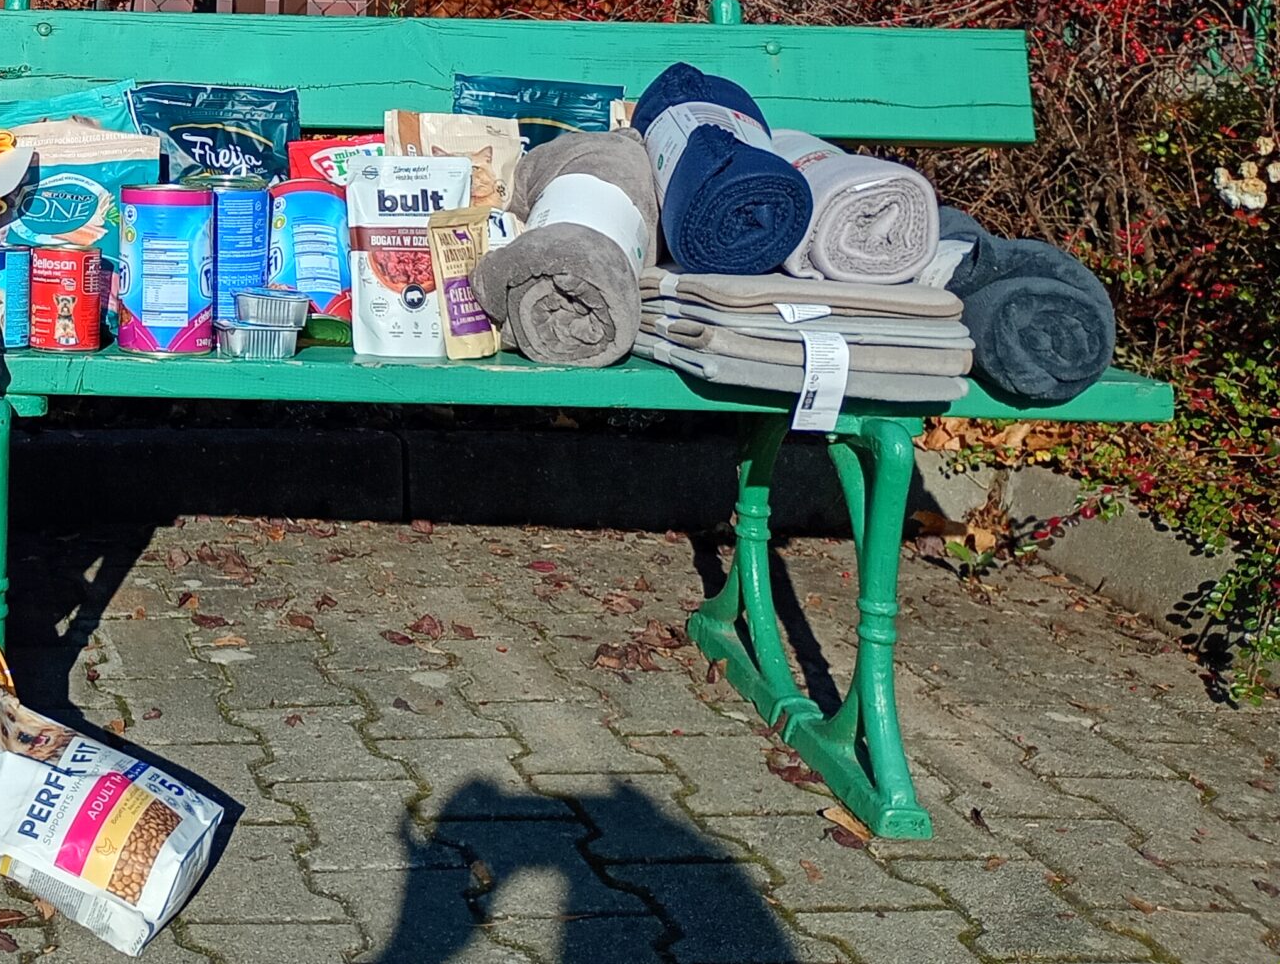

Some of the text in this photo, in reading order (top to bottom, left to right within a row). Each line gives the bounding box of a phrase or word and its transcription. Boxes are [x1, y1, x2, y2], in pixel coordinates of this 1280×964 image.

[182, 133, 263, 178] Freija
[335, 148, 360, 160] mini
[22, 196, 91, 218] ONE
[377, 189, 444, 213] bult
[371, 235, 402, 246] BOGATA
[403, 235, 411, 246] W
[32, 253, 77, 271] Bellosan
[159, 779, 185, 798] 5
[87, 782, 117, 821] ADULT
[43, 793, 75, 846] SUPPORTS
